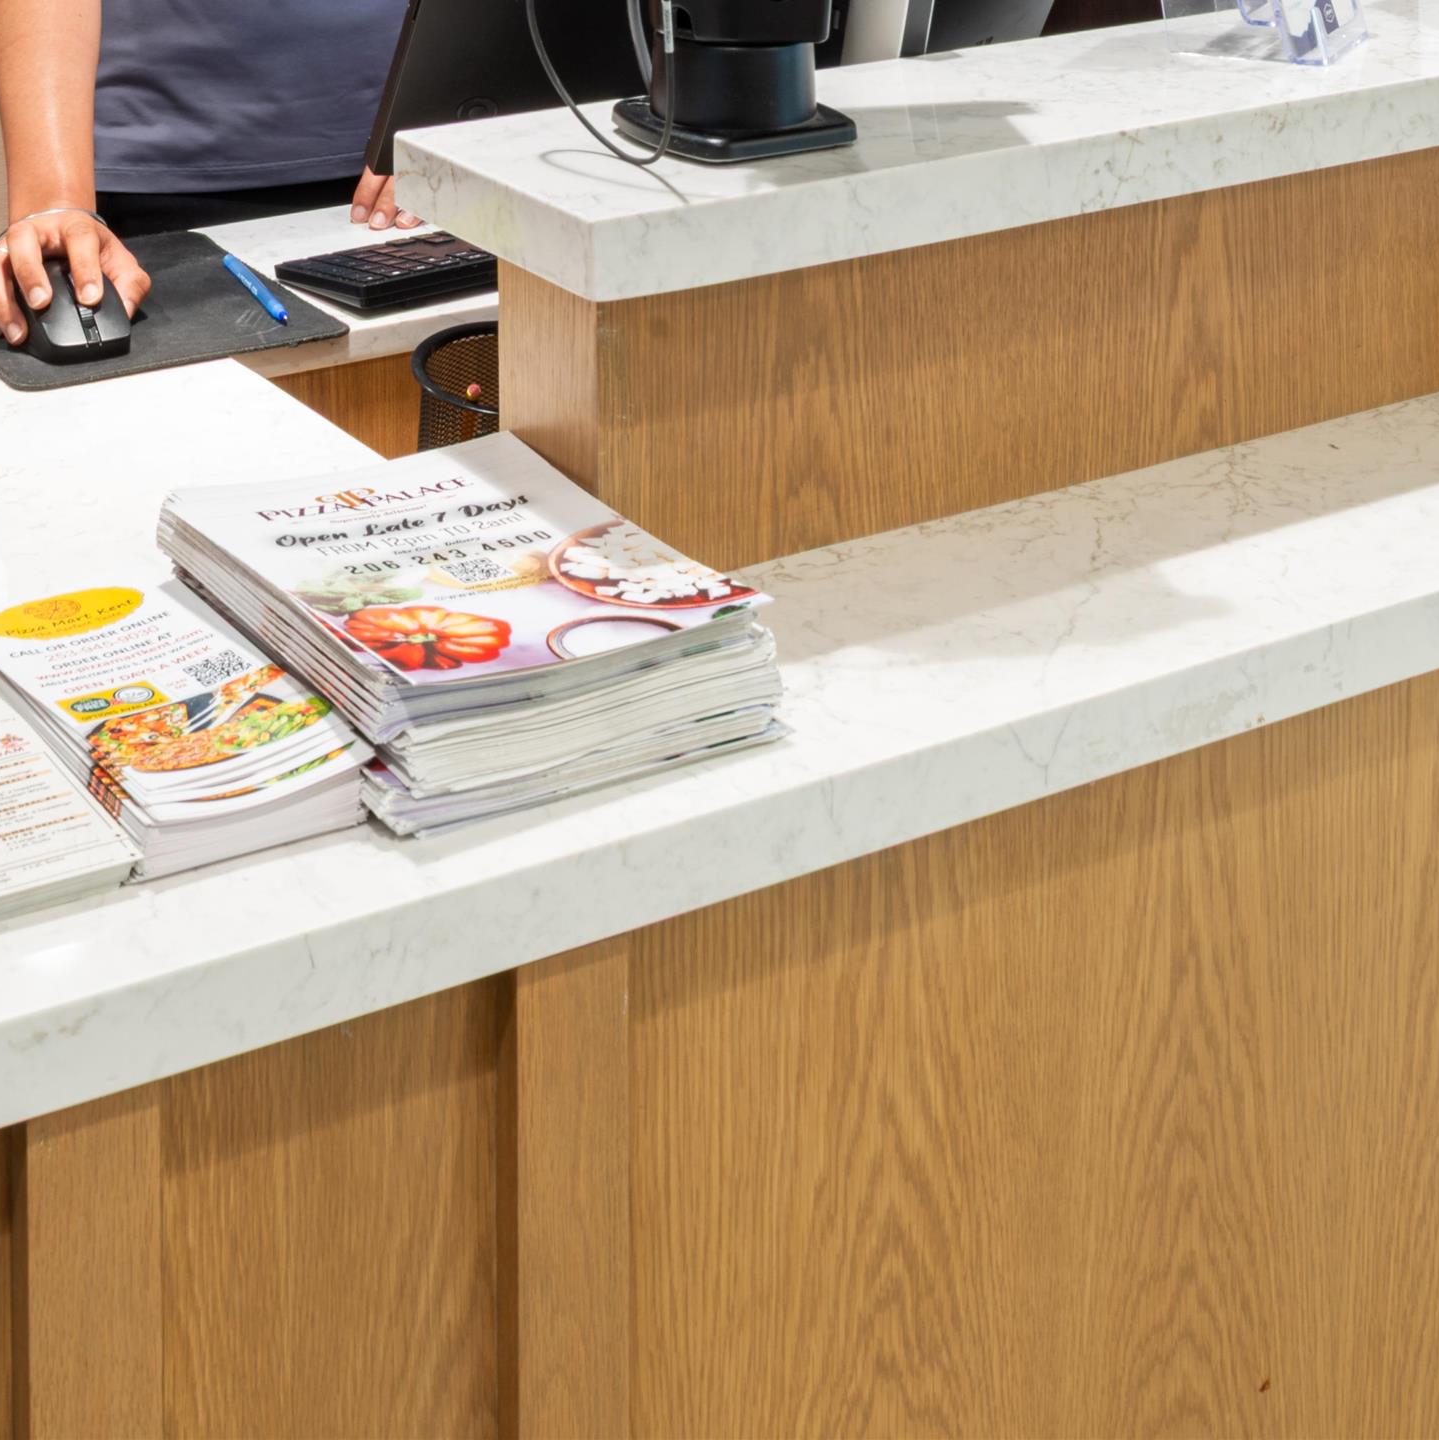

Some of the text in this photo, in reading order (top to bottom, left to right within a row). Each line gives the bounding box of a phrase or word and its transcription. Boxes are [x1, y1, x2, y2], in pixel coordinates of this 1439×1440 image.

[256, 476, 474, 523] PIZZA PALACE
[275, 493, 530, 548] Open Late 7 Days
[315, 513, 528, 557] FROM 12pm TO 2am!
[343, 529, 552, 576] 206.243.4500
[444, 536, 481, 548] Delivery
[5, 598, 134, 637] Pizza Mart Kent
[9, 610, 172, 659] CALL OR ORDER ONLINE
[51, 631, 174, 671] ORDER ONLINE AT
[62, 680, 105, 695] OPEN
[109, 676, 115, 685] 7
[117, 667, 156, 683] DAYS
[159, 662, 171, 671] A
[170, 645, 213, 665] WEEK
